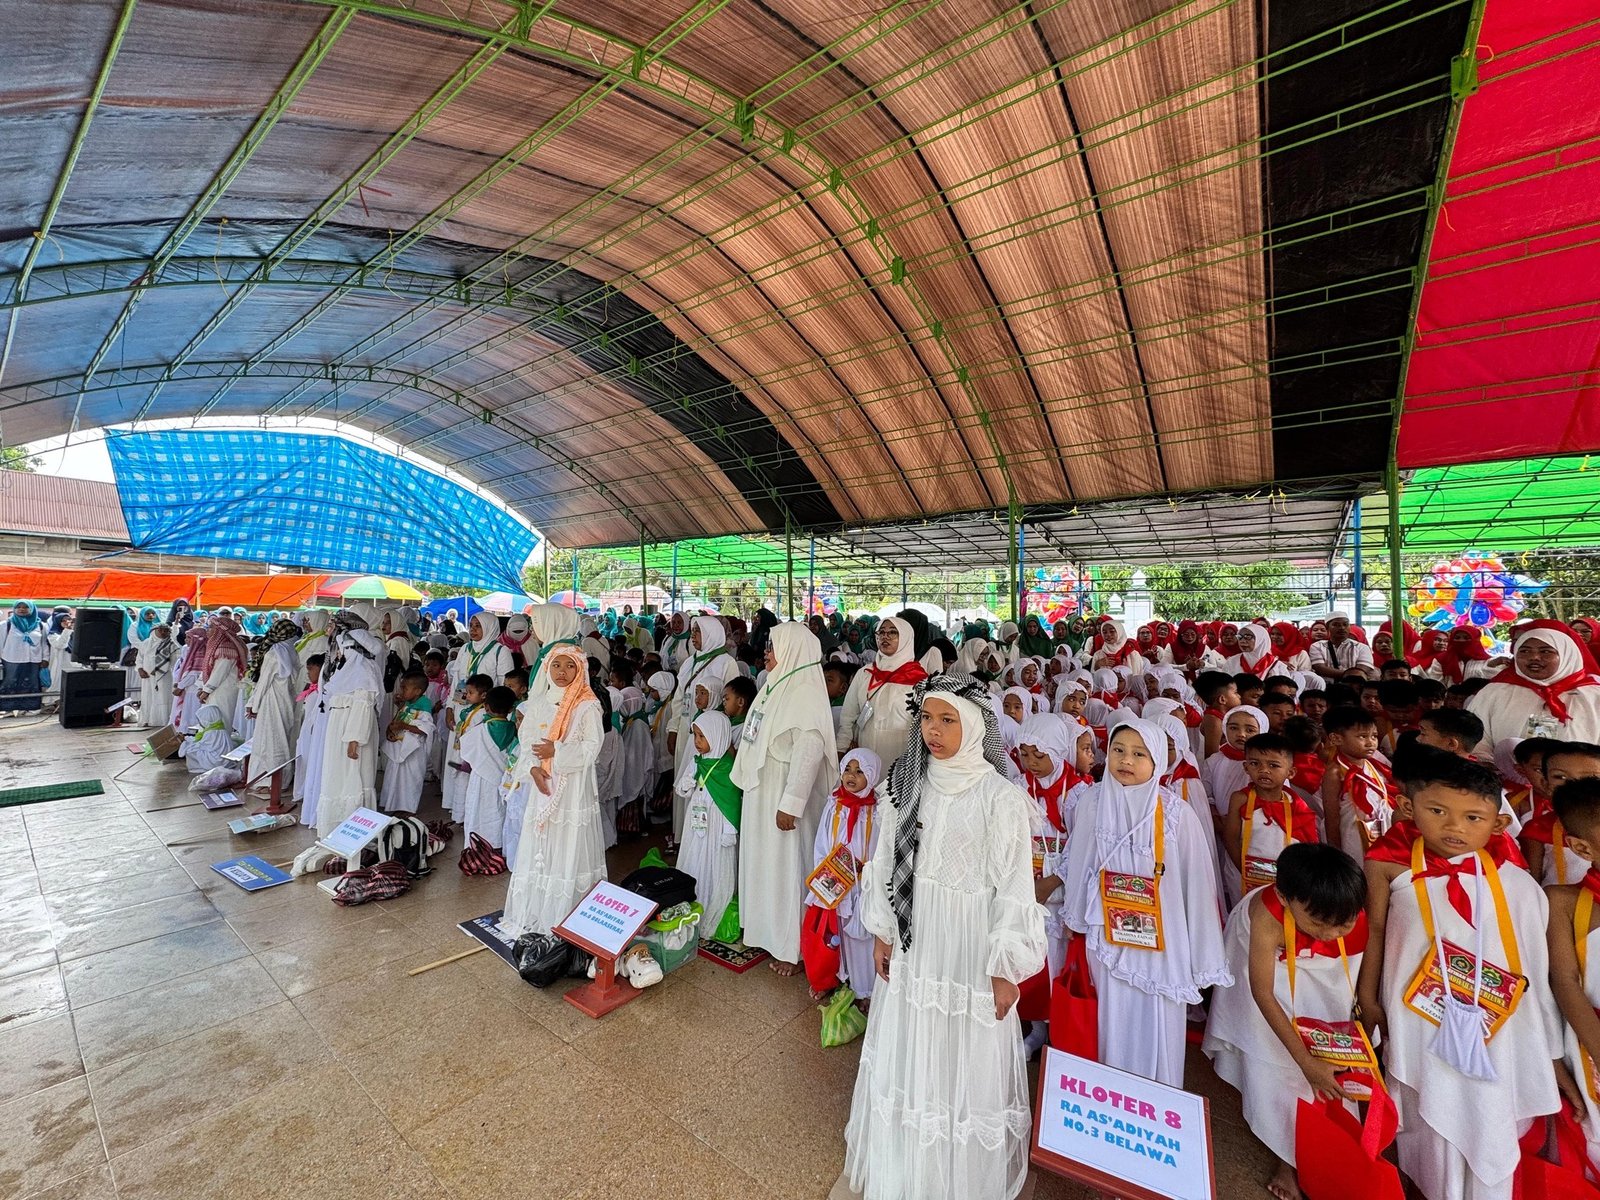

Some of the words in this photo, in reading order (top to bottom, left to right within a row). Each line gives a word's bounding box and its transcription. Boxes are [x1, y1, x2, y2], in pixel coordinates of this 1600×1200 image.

[593, 893, 630, 914] KLOTER
[629, 909, 640, 917] 7
[597, 909, 624, 926] AS'ADIYAH
[1060, 1074, 1157, 1121] KLOTER
[1164, 1110, 1182, 1130] 8
[1060, 1099, 1082, 1116] RA
[1086, 1110, 1180, 1152] AS'ADIYAH
[1064, 1116, 1099, 1138] NO.3
[1104, 1131, 1177, 1168] BELAWA
